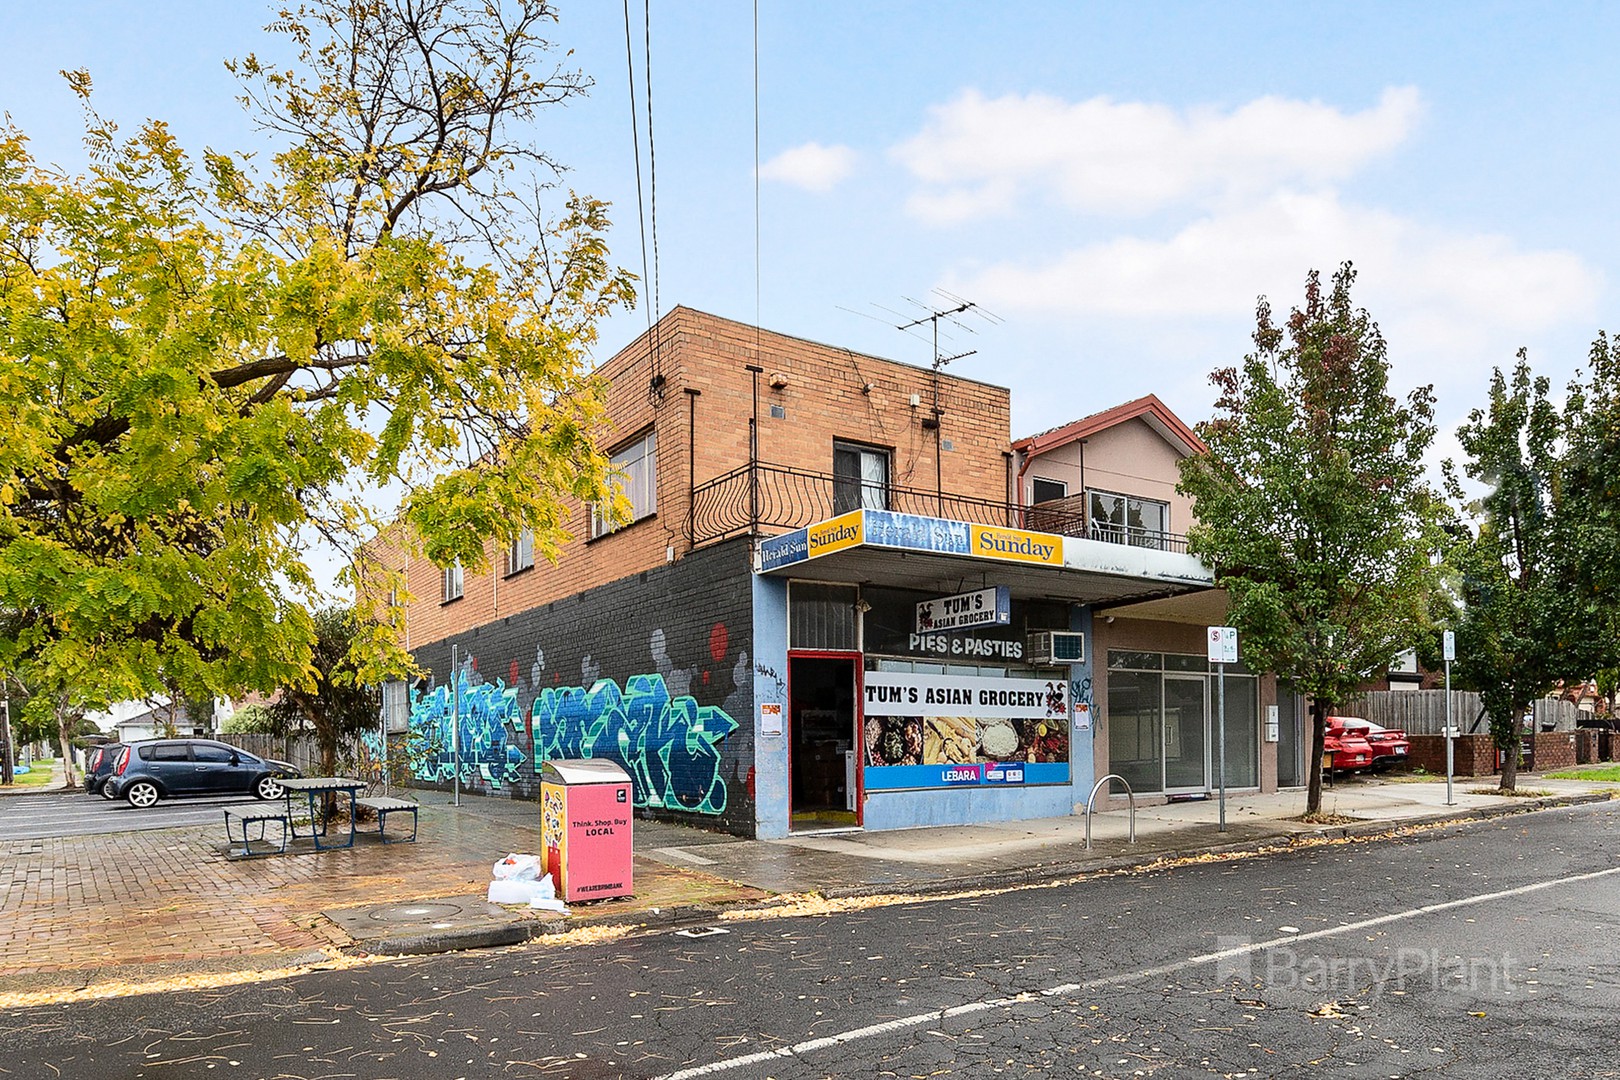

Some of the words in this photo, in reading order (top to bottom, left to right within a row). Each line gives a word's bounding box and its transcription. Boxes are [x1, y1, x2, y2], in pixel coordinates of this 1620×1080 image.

[810, 524, 860, 549] Sunday
[871, 516, 926, 541] Herald
[934, 526, 963, 546] Sun
[762, 544, 788, 563] Herald
[790, 540, 807, 555] Sun
[980, 531, 1055, 561] Sunday
[943, 593, 983, 615] TUM'S
[934, 617, 956, 630] ASIAN
[958, 609, 995, 625] GROCERY
[909, 633, 948, 653] PIES
[964, 637, 1023, 659] PASTIES
[865, 685, 918, 704] TUM'S
[925, 687, 973, 705] ASIAN
[979, 689, 1045, 707] GROCERY
[941, 769, 977, 782] LEBARA
[586, 828, 615, 837] LOCAL
[594, 819, 613, 828] Shop.
[614, 818, 628, 826] Buy
